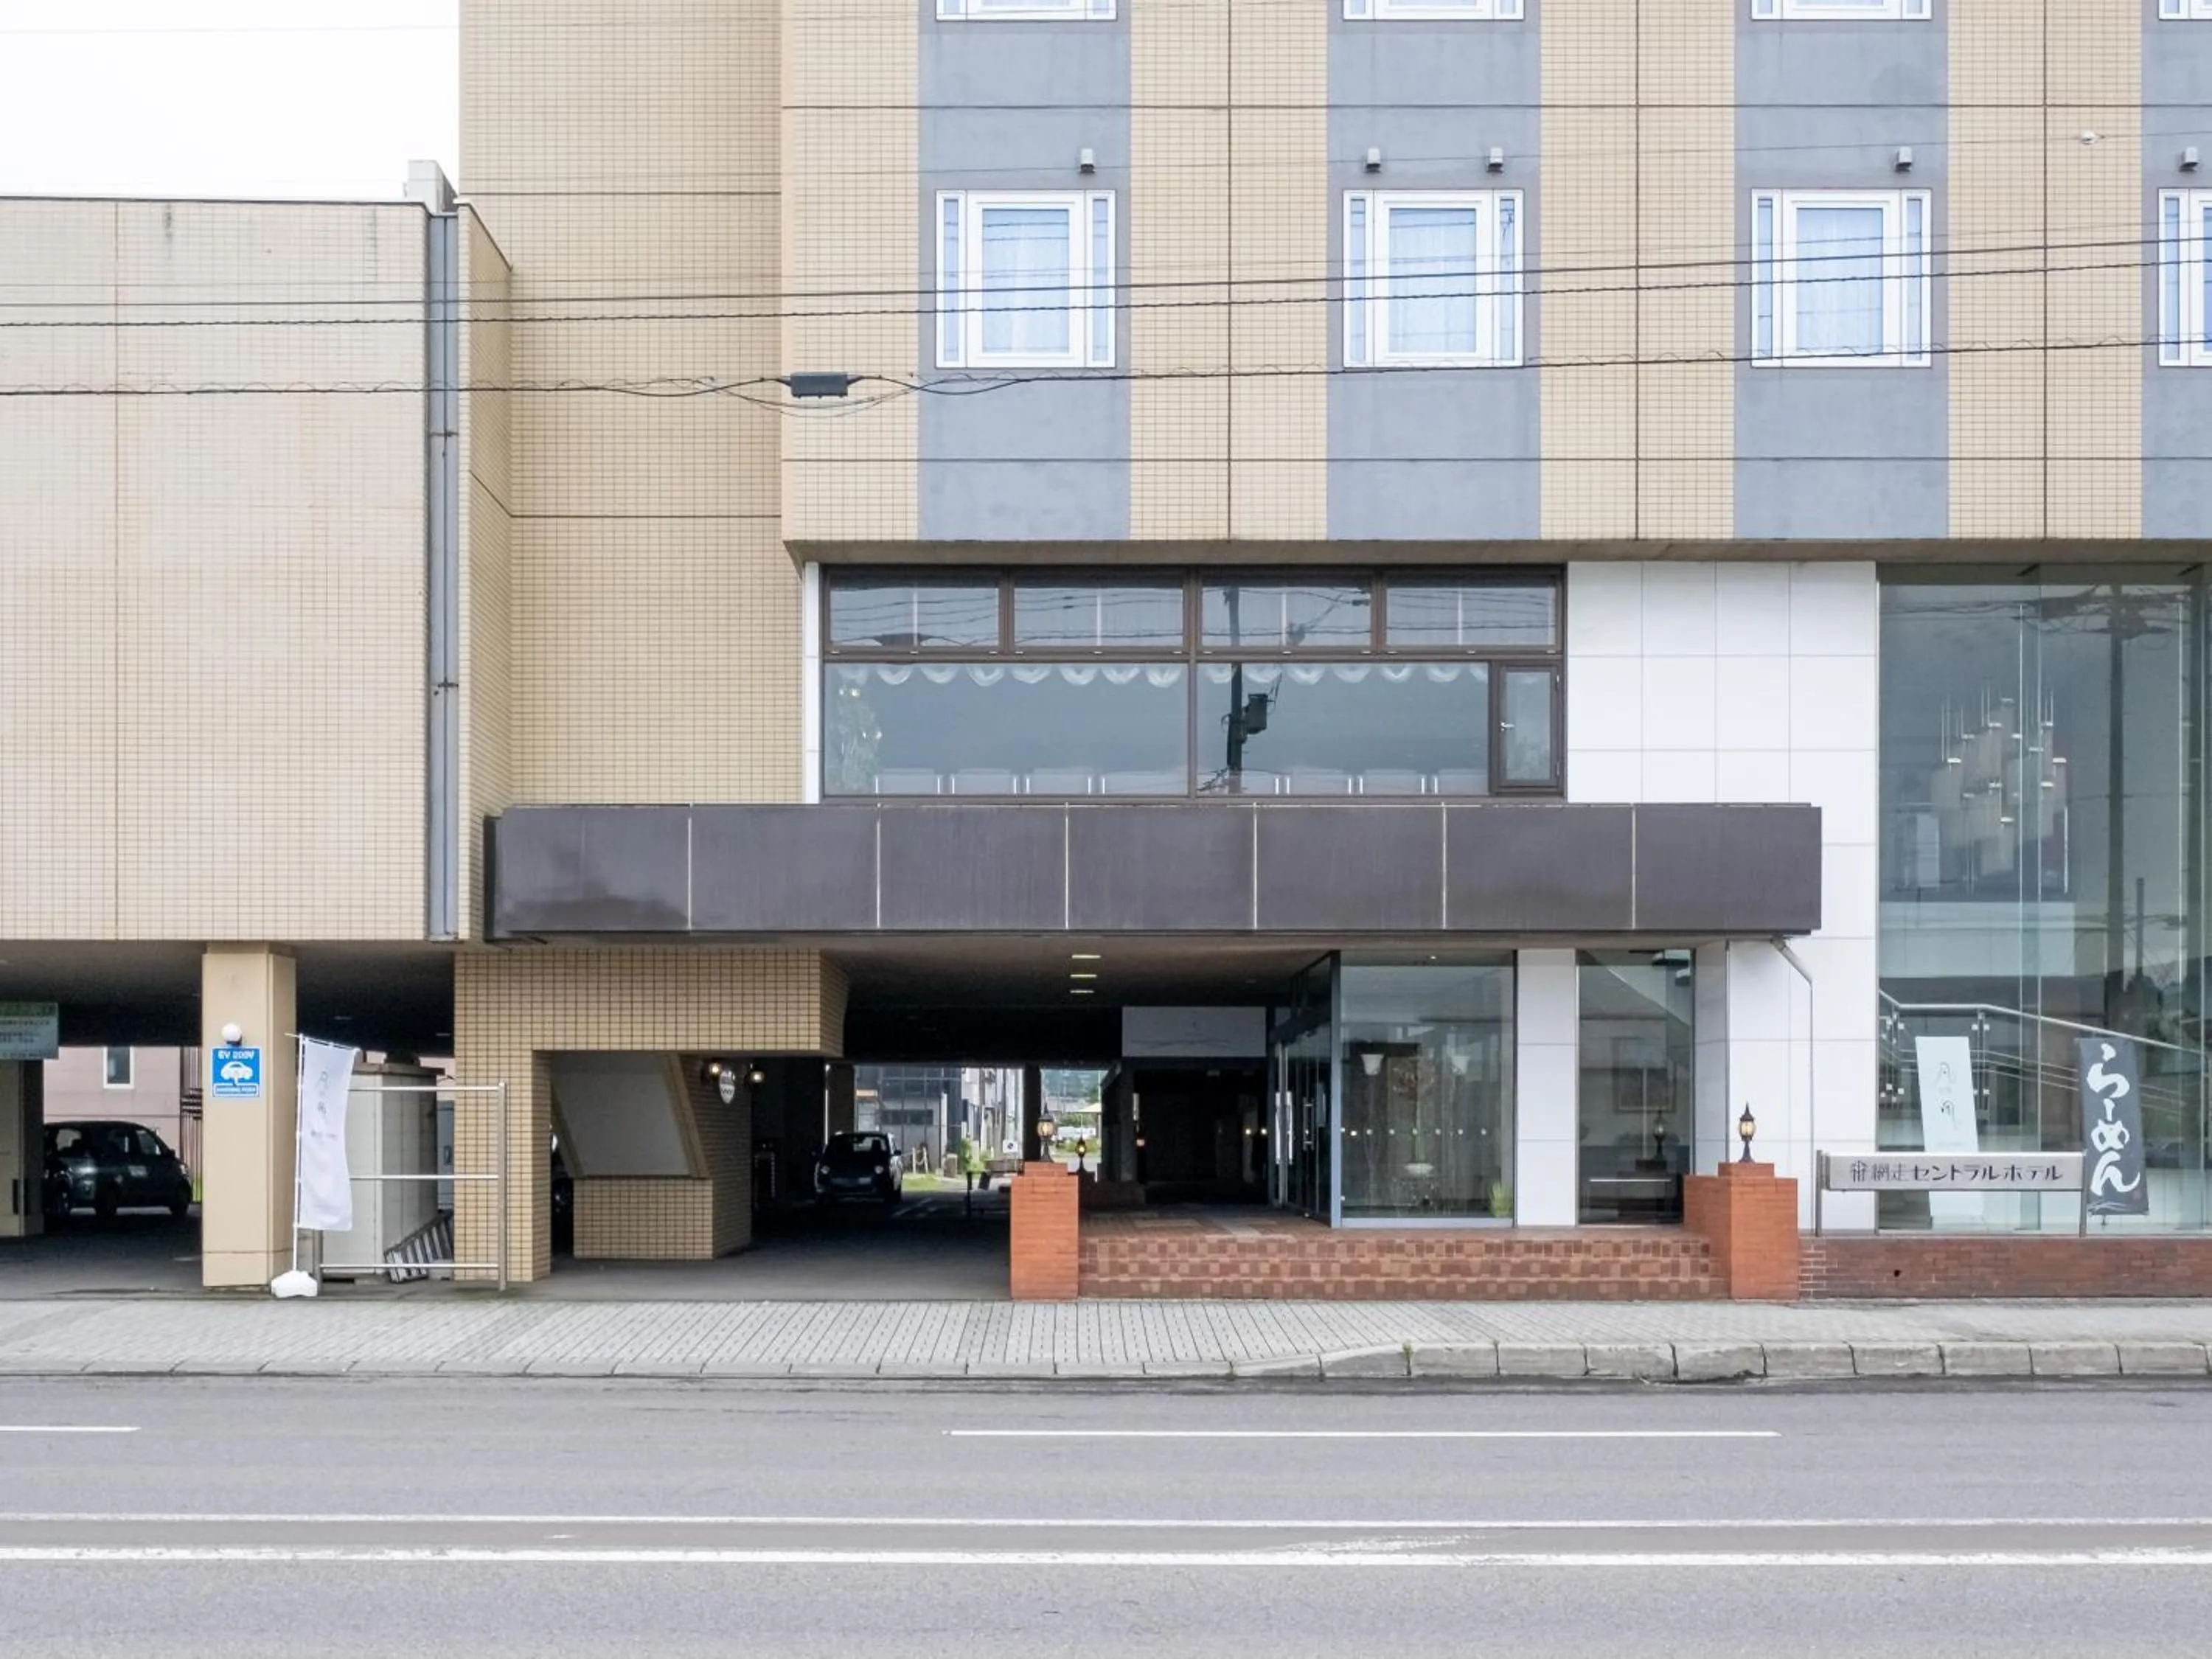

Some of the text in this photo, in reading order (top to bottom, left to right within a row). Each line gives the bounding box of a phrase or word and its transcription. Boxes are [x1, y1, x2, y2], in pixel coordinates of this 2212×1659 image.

[2086, 1043, 2140, 1196] らーめん
[1872, 1163, 2063, 1181] 網走セントラルホテル
